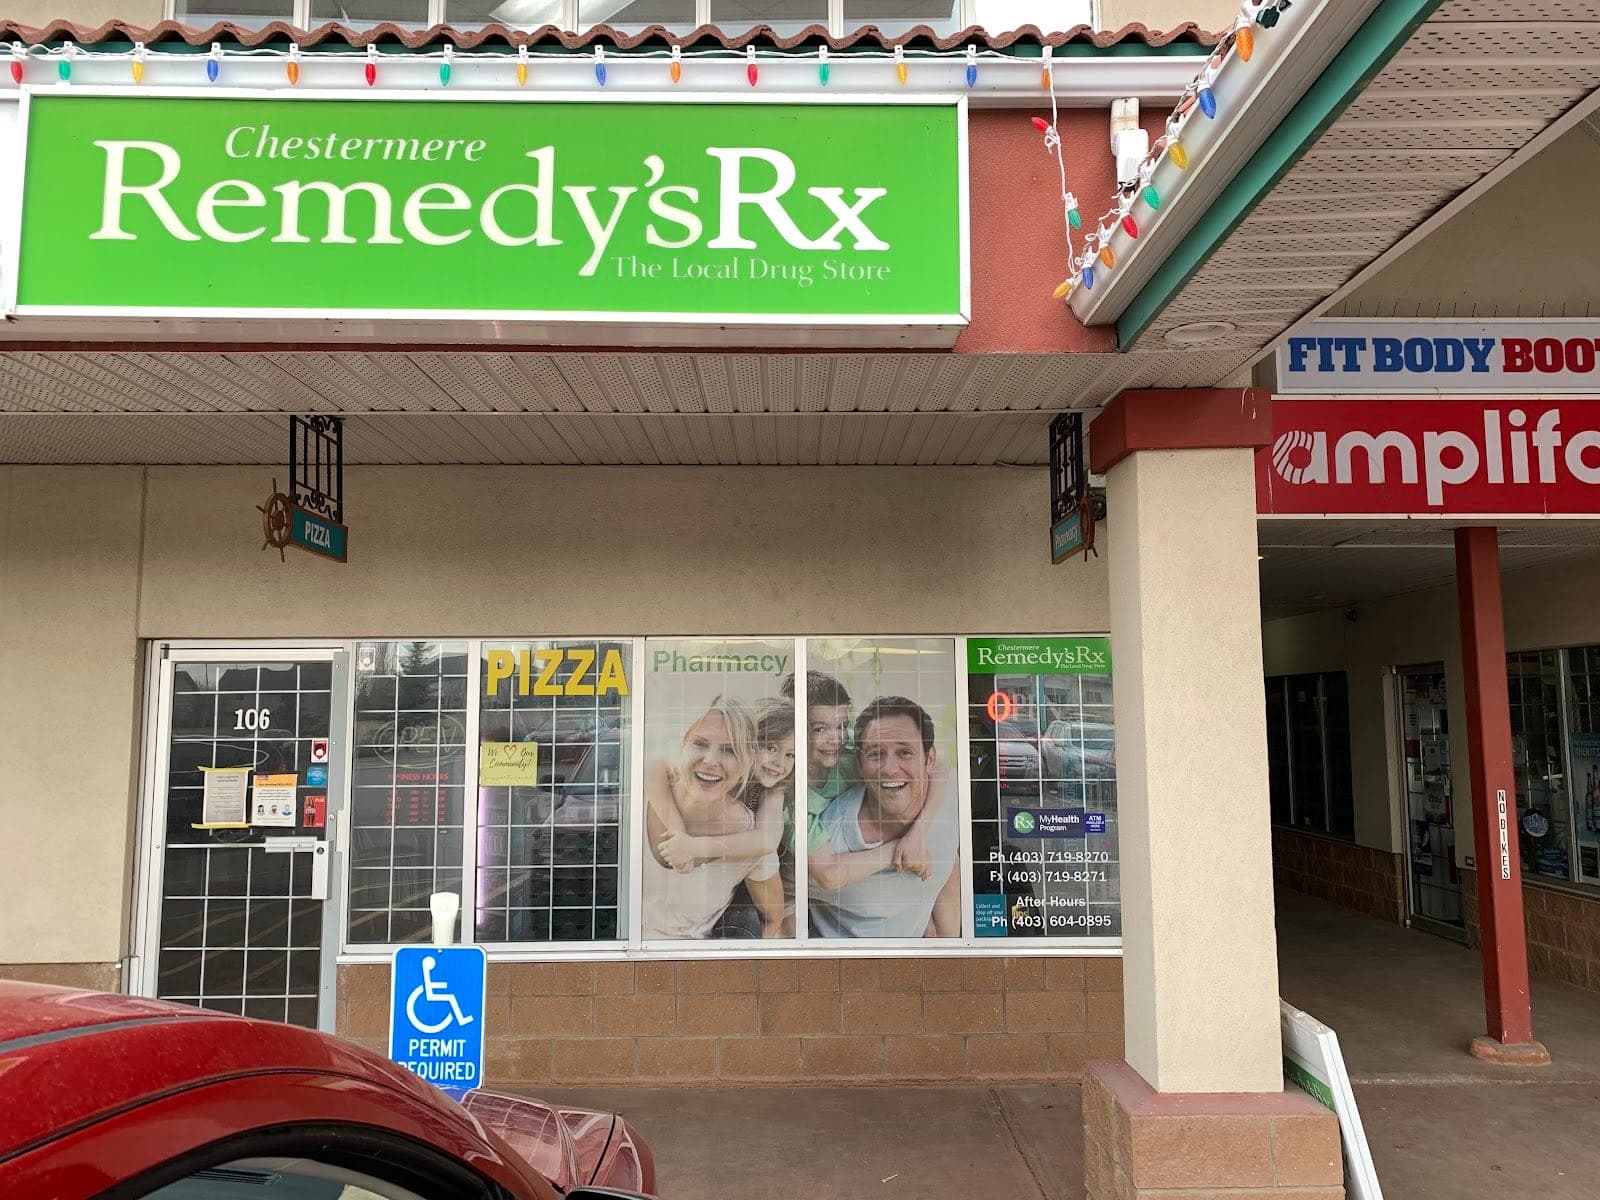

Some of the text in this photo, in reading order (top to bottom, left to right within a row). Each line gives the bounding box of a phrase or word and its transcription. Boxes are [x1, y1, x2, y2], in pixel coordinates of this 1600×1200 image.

[224, 124, 487, 163] Chestermere
[610, 255, 891, 288] The Local Drug Store
[1287, 337, 1600, 374] FIT BODY BOO
[304, 520, 331, 549] PIZZA
[997, 644, 1041, 652] Chestermere
[486, 649, 630, 696] PIZZA
[653, 650, 788, 677] Pharmacy
[233, 708, 271, 731] 106
[1014, 814, 1080, 829] Rx MyHealth
[1498, 791, 1509, 879] NO BIKES
[989, 851, 1109, 864] Ph (403) 719-8270
[990, 870, 1107, 883] Fx (403) 719-8271
[1015, 896, 1086, 907] After Hours
[991, 915, 1112, 930] Ph (403) 604-0895
[408, 1038, 467, 1058] PERMIT
[397, 1061, 476, 1081] EQUIRED
